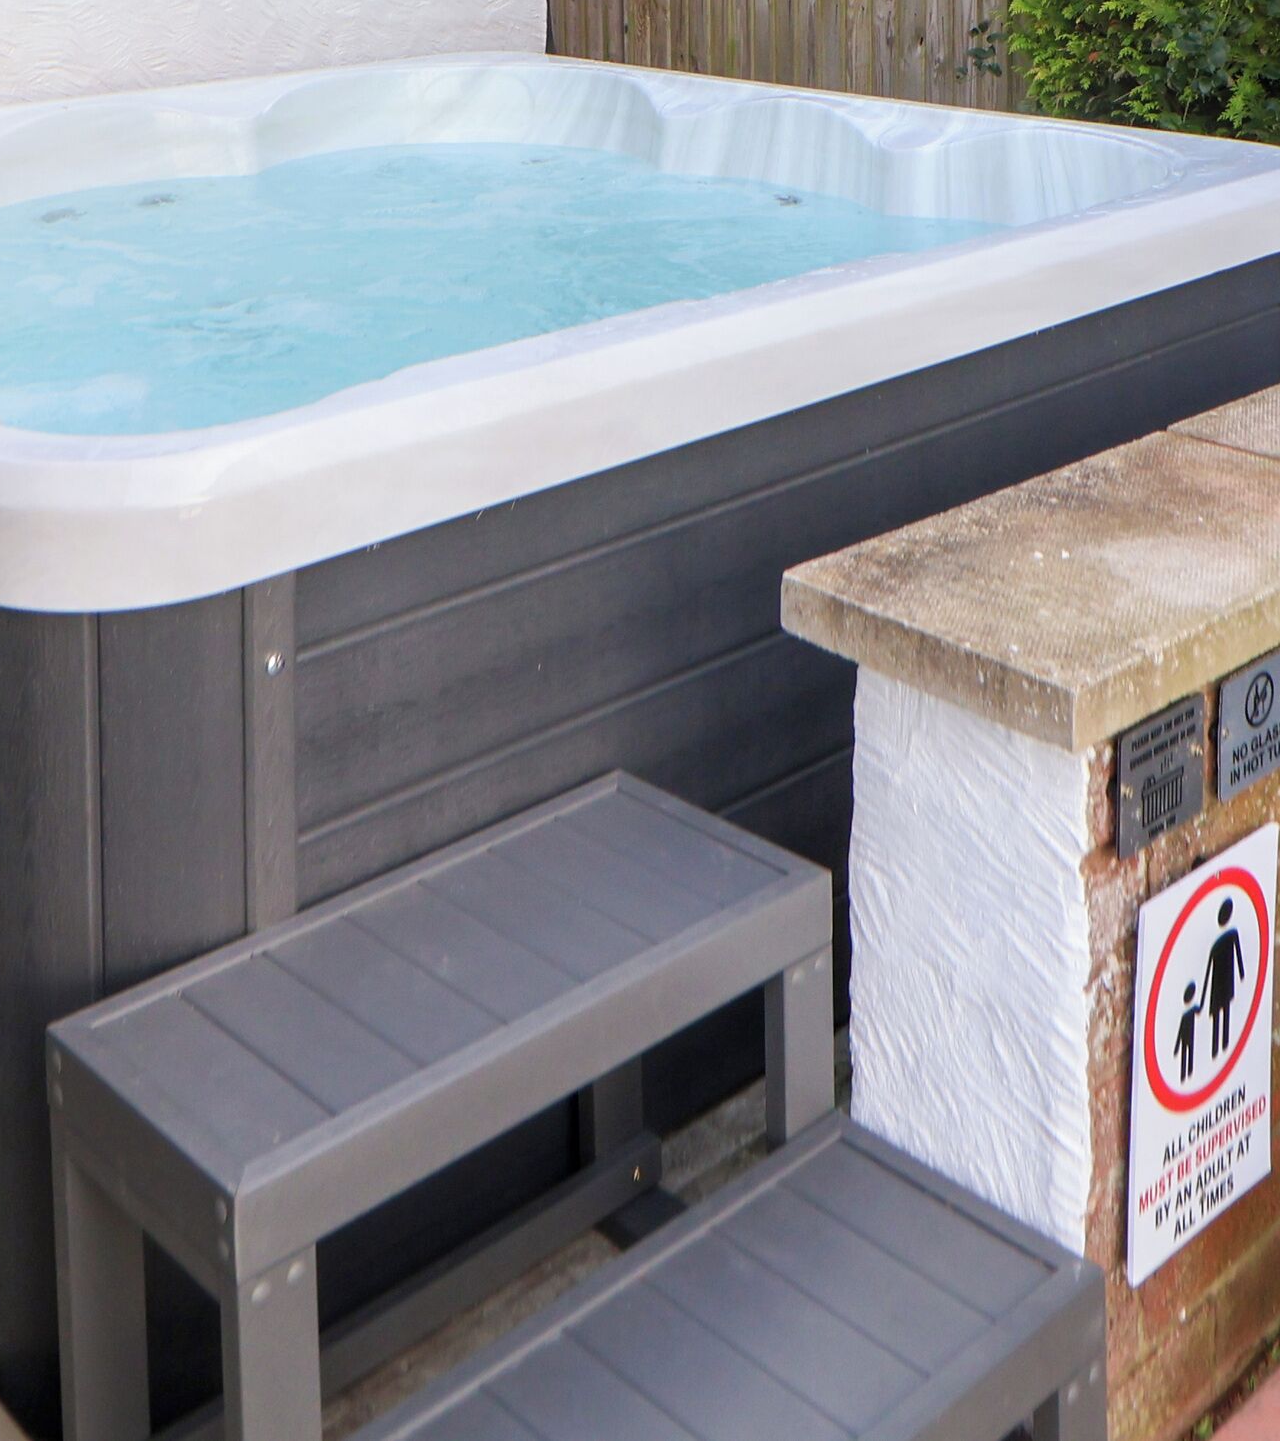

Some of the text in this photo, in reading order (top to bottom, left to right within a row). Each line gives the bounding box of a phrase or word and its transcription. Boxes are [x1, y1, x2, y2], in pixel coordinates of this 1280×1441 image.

[1231, 767, 1240, 786] IN
[1244, 756, 1264, 778] HOT
[1233, 744, 1248, 764] NO
[1139, 1095, 1266, 1215] MUST BE SUPERVISED
[1163, 1084, 1246, 1167] ALL CHILDREN
[1155, 1134, 1251, 1229] BY AN ADULT AT
[1173, 1173, 1234, 1242] ALL TIMES
